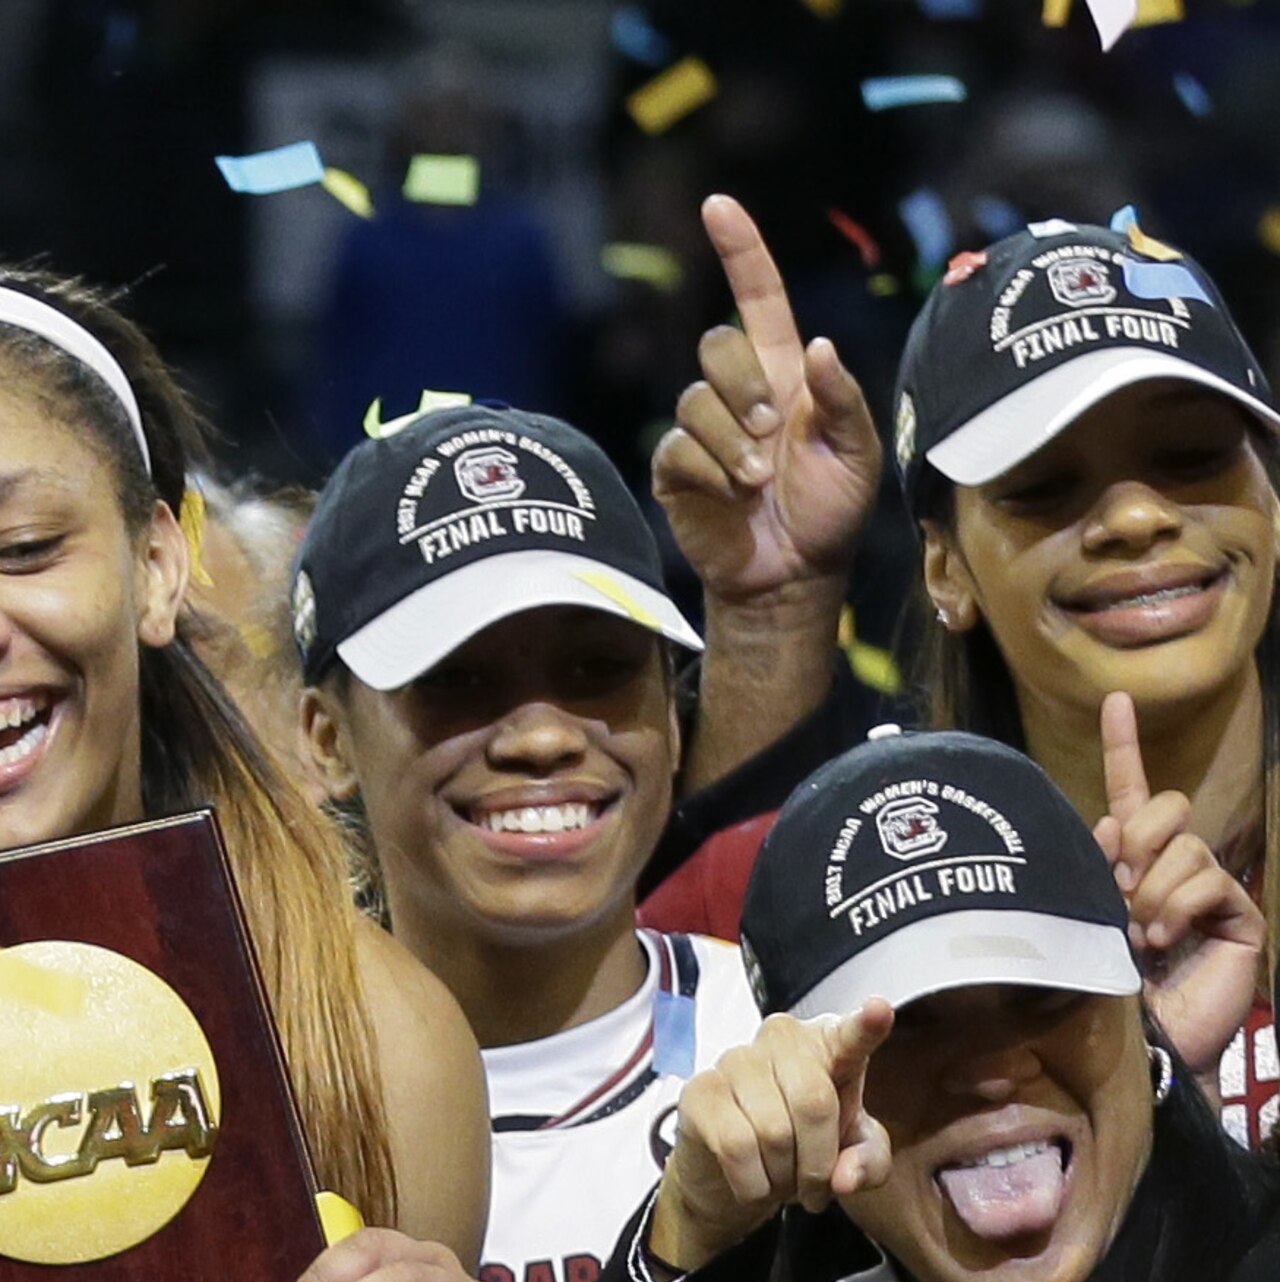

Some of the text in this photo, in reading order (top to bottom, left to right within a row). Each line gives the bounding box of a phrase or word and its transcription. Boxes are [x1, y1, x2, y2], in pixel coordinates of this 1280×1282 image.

[1031, 245, 1110, 269] WOMEN'S
[1011, 314, 1178, 367] FINAL FOUR
[396, 429, 596, 534] 2017 NCAA WOMEN'S BASKETBALL
[417, 508, 585, 564] FINAL FOUR
[825, 779, 1026, 906] 2017 NCAA WOMEN'S BASKETBALL
[848, 862, 1016, 937] FINAL FOUR
